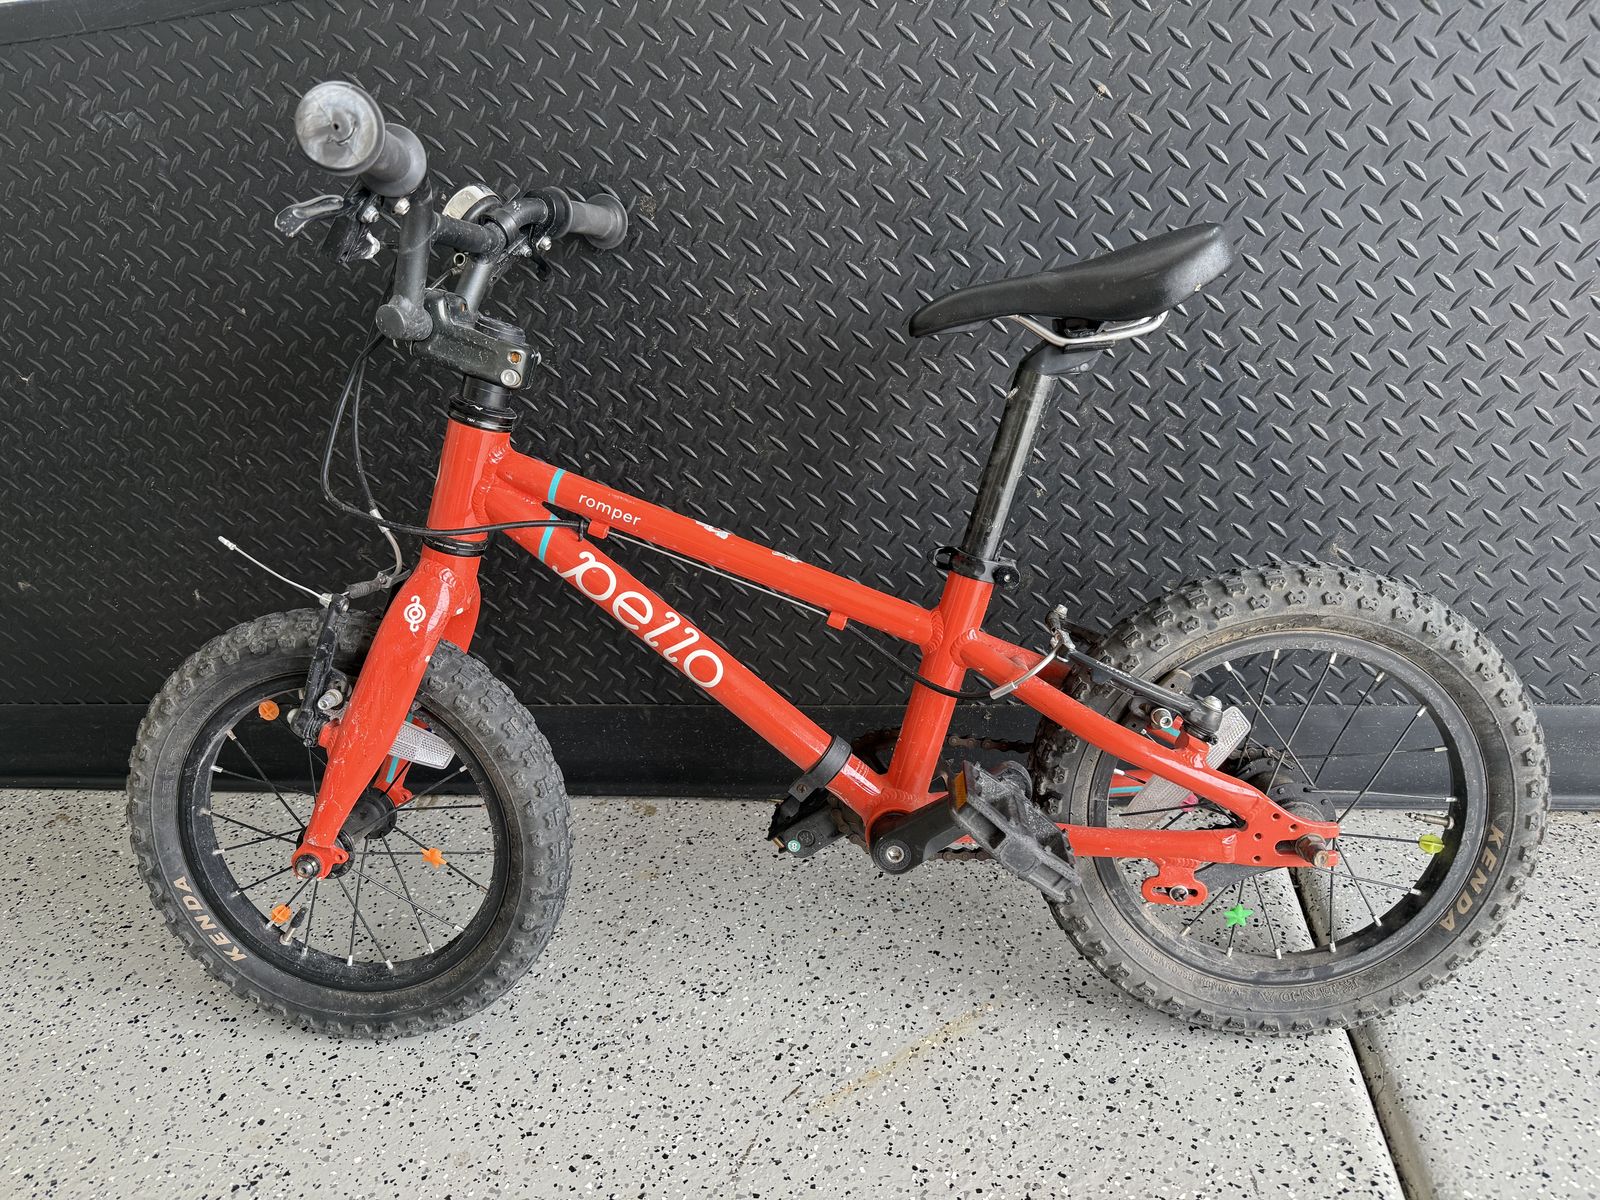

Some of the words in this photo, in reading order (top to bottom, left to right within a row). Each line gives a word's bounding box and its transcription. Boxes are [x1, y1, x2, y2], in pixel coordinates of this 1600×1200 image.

[578, 493, 641, 526] romper
[552, 551, 724, 688] pello
[173, 876, 247, 961] KENDA
[1439, 824, 1505, 931] KENDA
[1259, 978, 1360, 1003] KENDA
